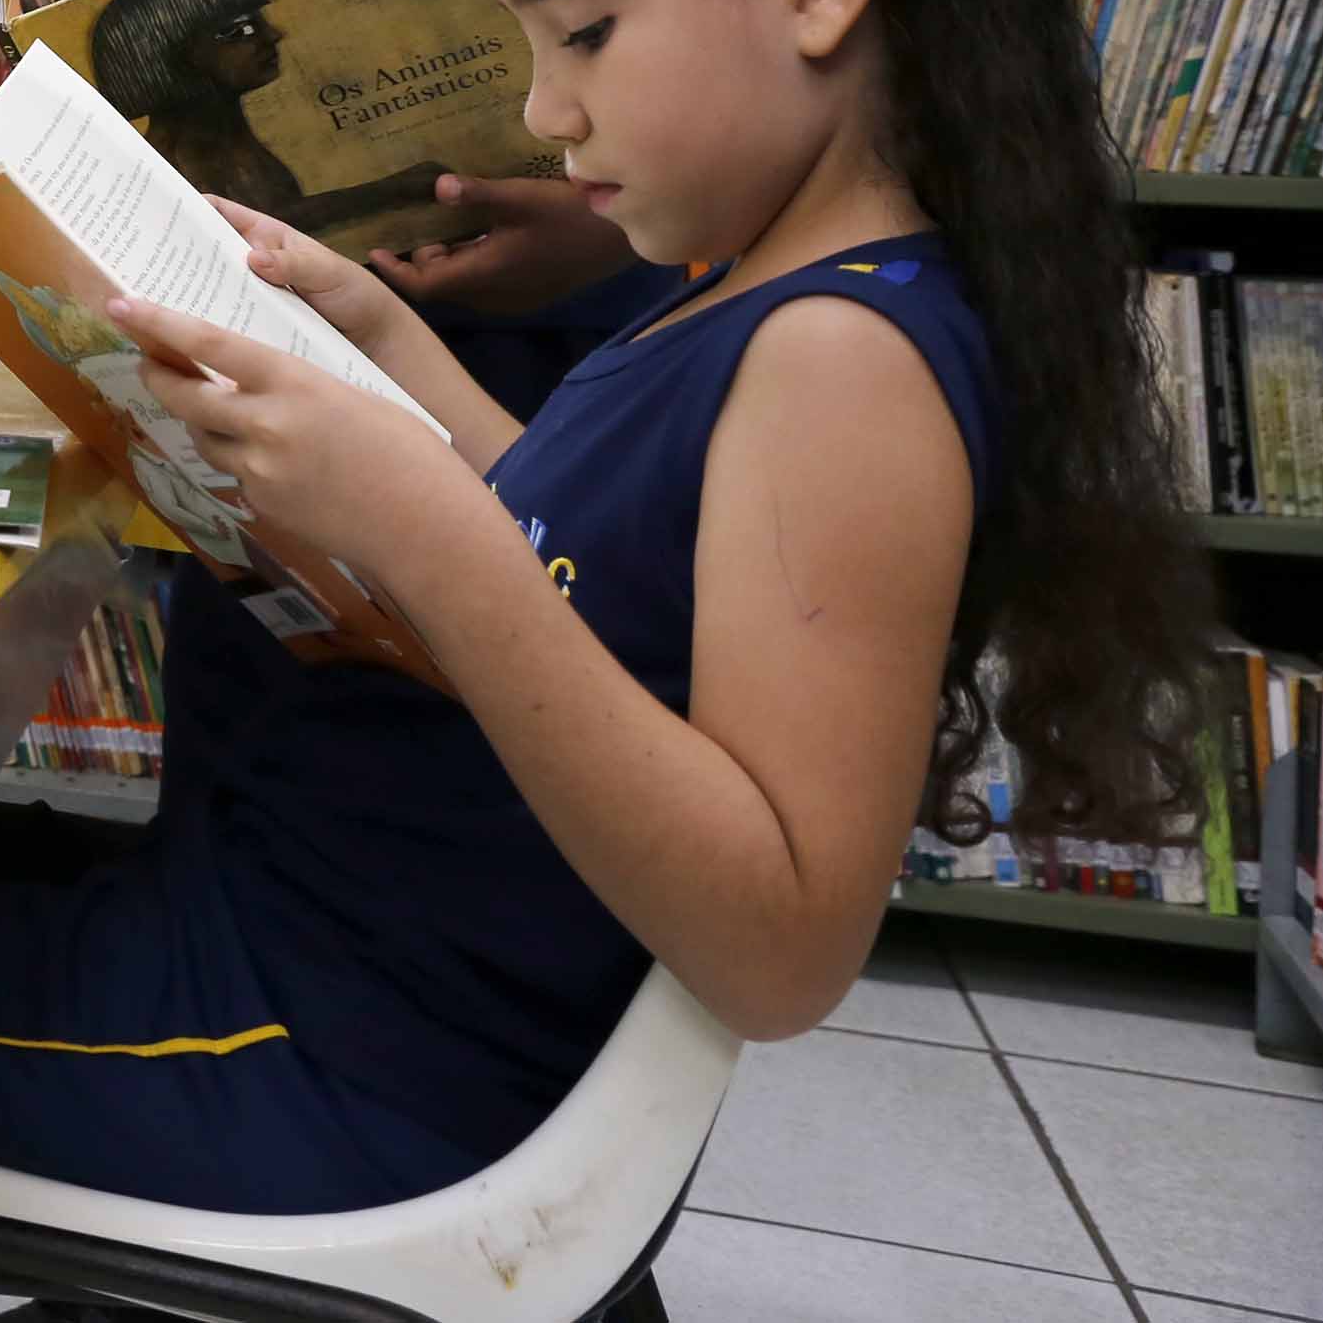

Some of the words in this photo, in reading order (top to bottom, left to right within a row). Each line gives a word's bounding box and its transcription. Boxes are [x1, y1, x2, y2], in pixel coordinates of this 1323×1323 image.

[318, 81, 363, 107] Os
[375, 34, 503, 91] Animais
[328, 61, 509, 131] Fantásticos
